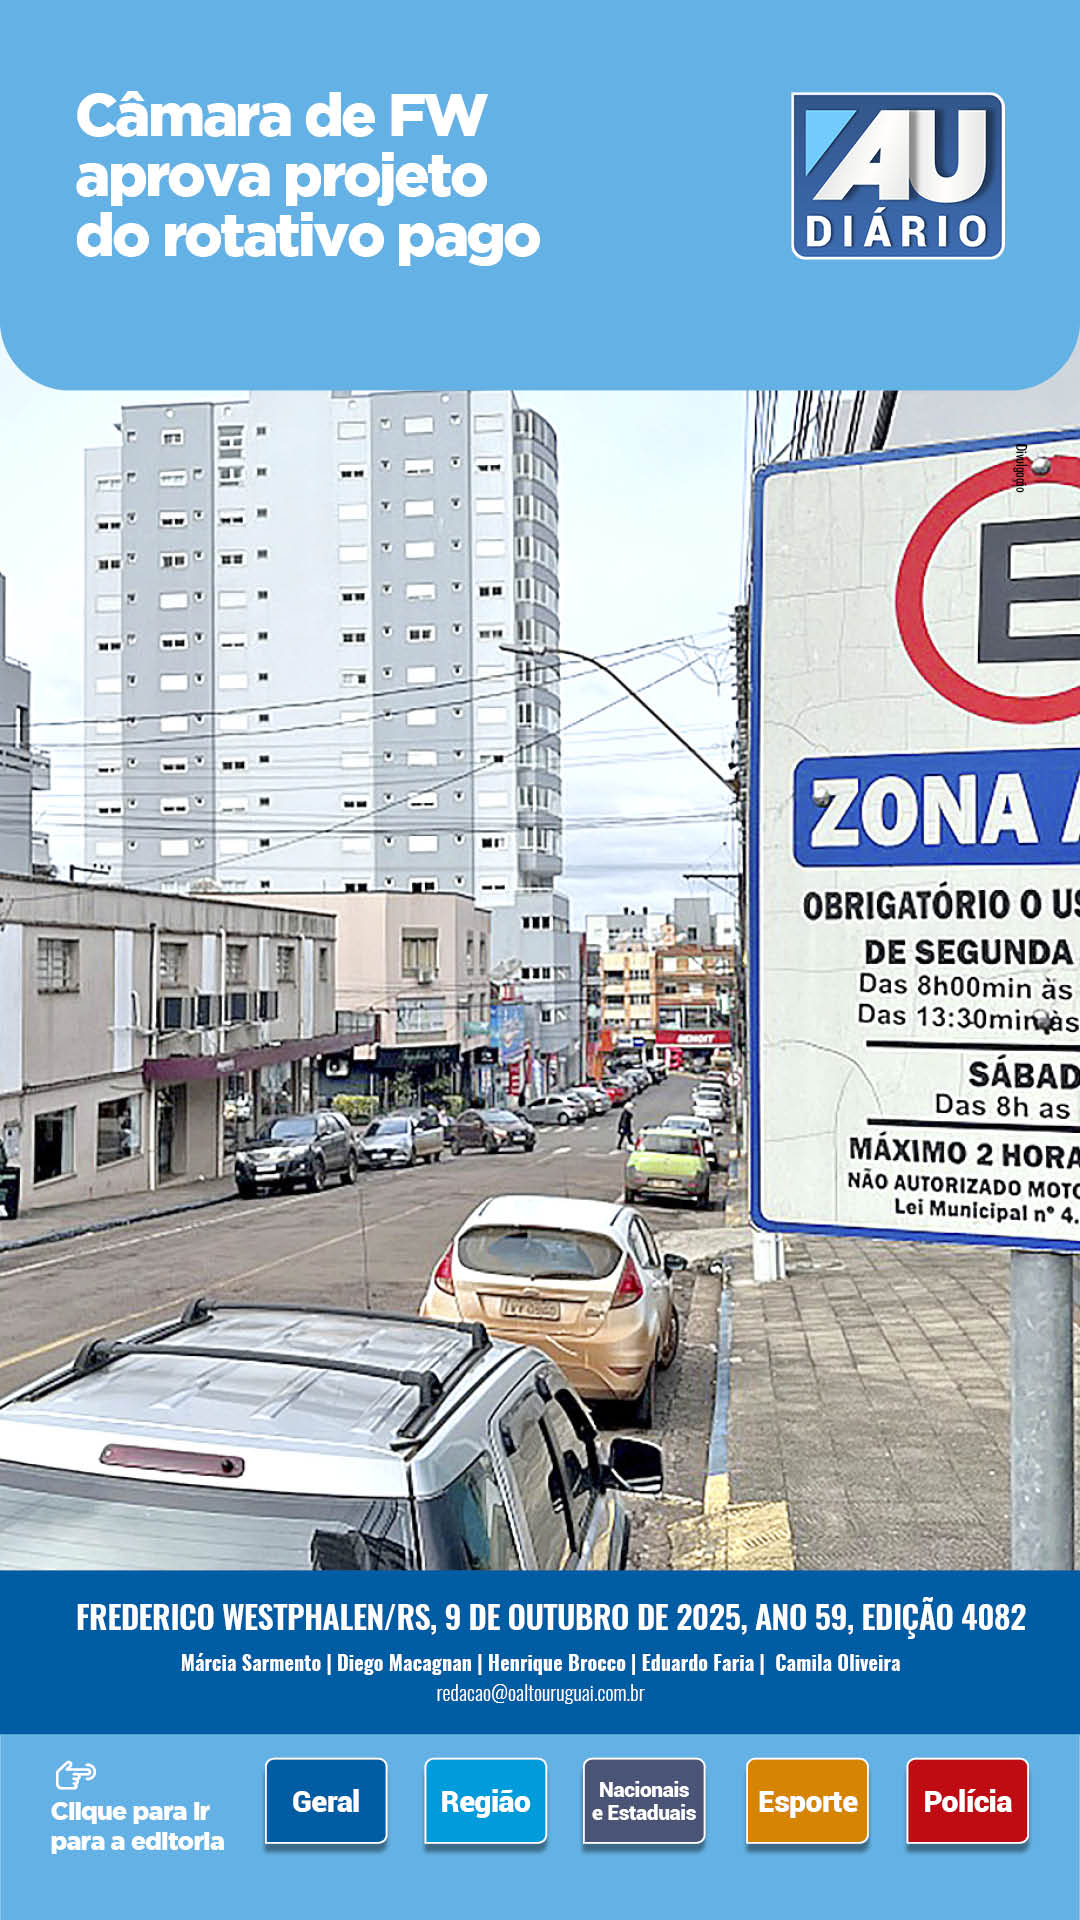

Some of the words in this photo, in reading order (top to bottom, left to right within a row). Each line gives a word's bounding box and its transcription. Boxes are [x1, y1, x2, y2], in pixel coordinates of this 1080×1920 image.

[978, 515, 1080, 663] E
[811, 773, 1039, 847] ZONA
[803, 881, 1010, 921] OBRIGATÓRIO
[1020, 889, 1042, 919] O
[865, 939, 906, 965] DE
[915, 938, 1074, 965] SEGUNDA
[859, 972, 908, 994] Das
[917, 974, 1032, 999] 8h00min
[858, 1003, 906, 1026] Das
[917, 1006, 1040, 1031] 13:30min
[1049, 1009, 1080, 1032] às
[936, 1093, 986, 1117] Das
[997, 1096, 1028, 1118] 8h
[1039, 1102, 1071, 1120] as
[849, 1131, 967, 1165] MÁXIMO
[976, 1143, 993, 1166] 2
[1002, 1143, 1080, 1169] HORA
[848, 1167, 888, 1190] NÃO
[894, 1174, 1021, 1196] AUTORIZADO
[895, 1197, 924, 1215] Lei
[929, 1199, 1028, 1223] Municipal
